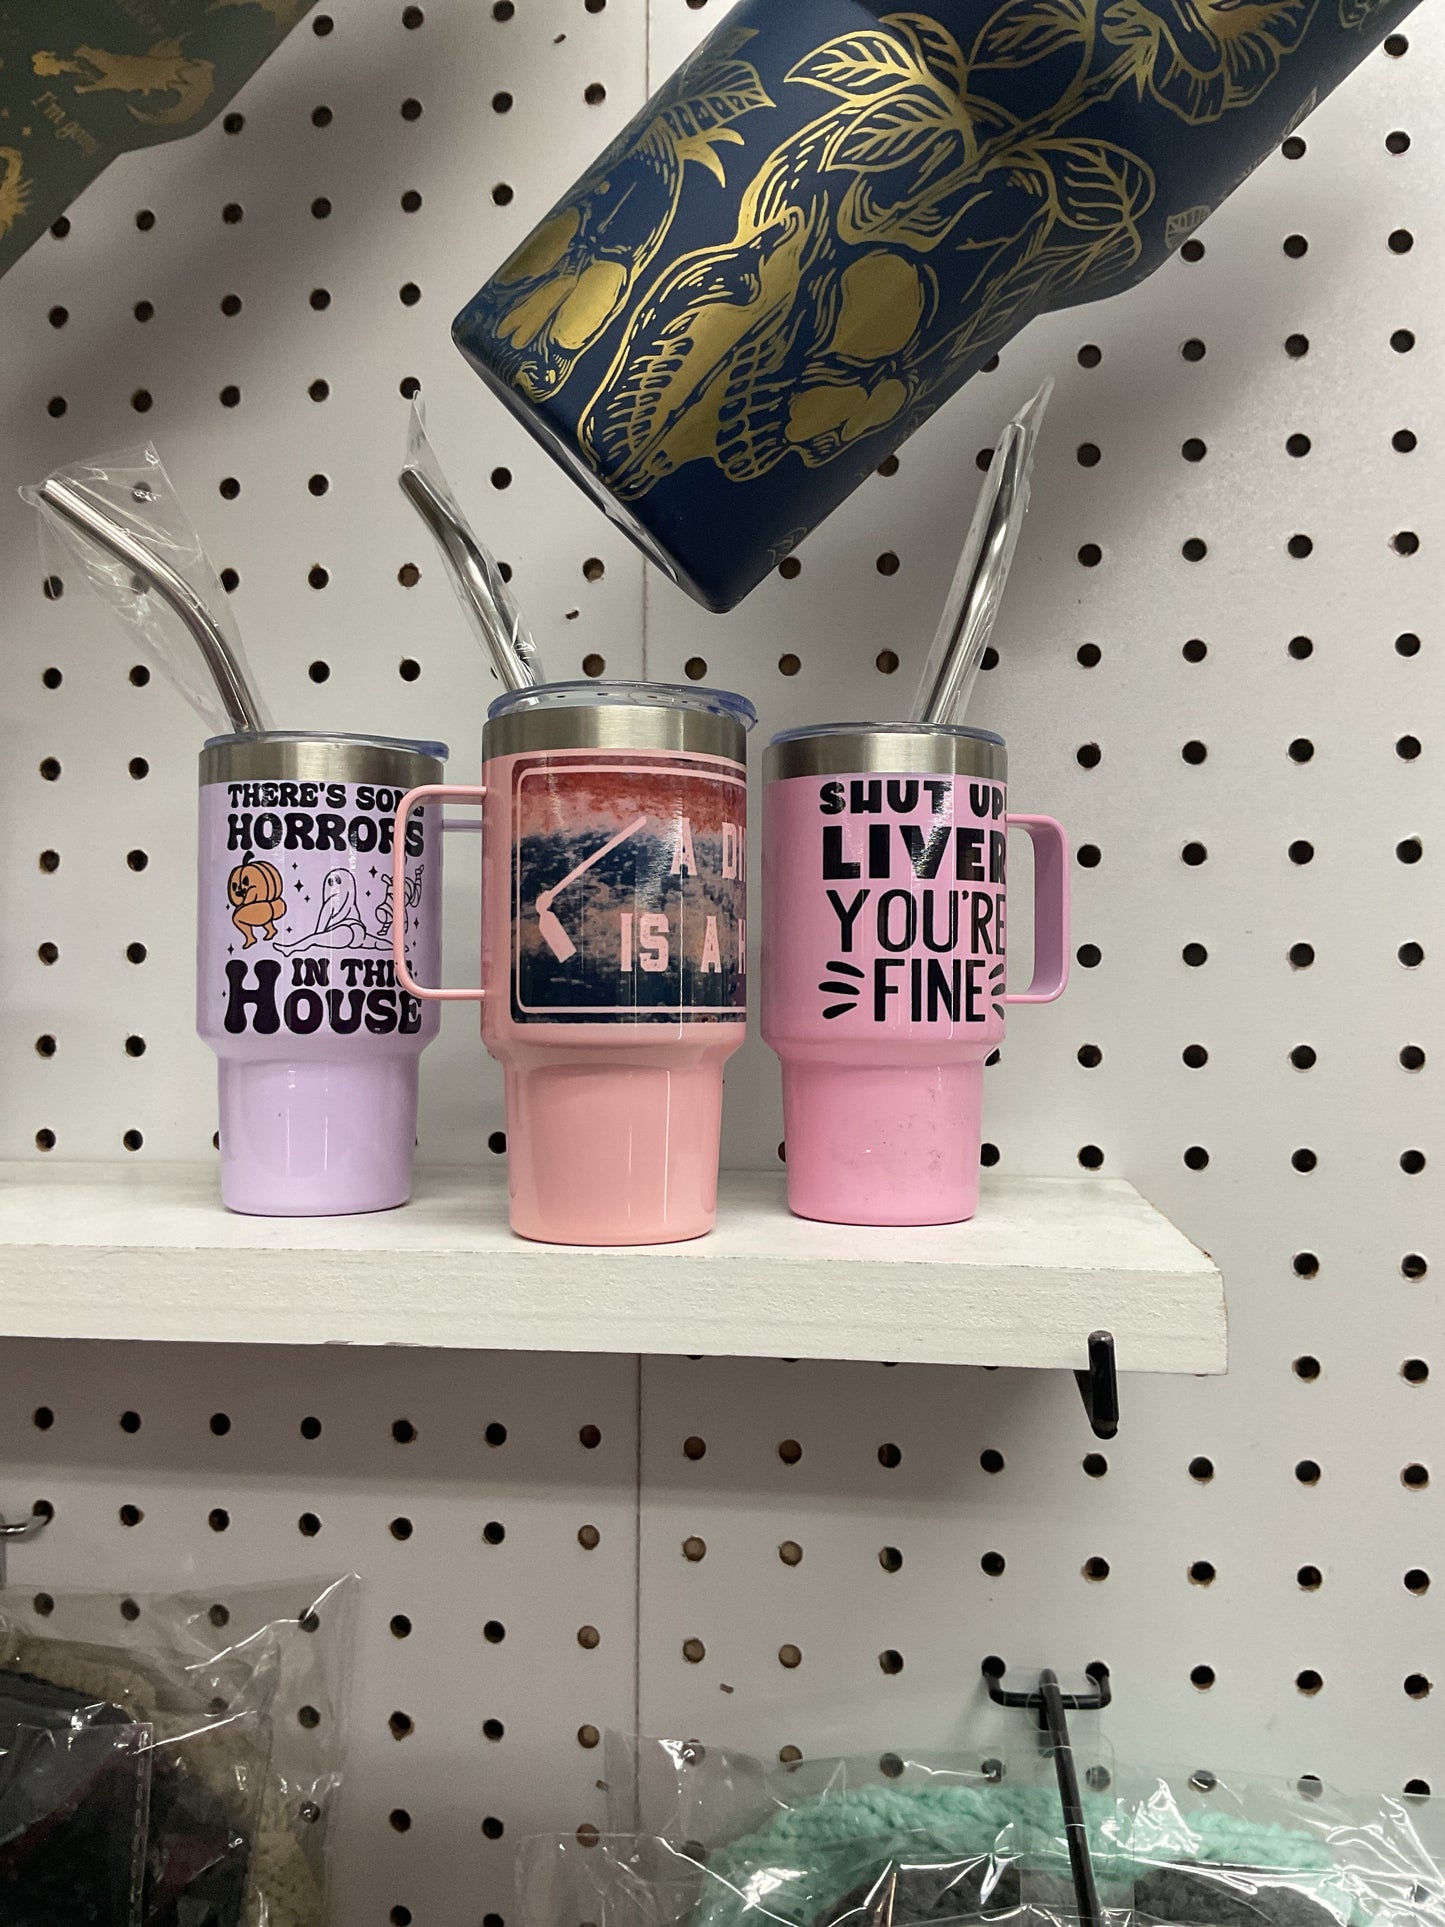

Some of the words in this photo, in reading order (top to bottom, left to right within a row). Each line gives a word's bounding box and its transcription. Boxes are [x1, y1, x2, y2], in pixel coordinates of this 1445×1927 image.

[227, 783, 346, 808] THERE'S
[356, 786, 424, 817] SO
[819, 780, 953, 814] SHUT
[227, 812, 424, 857] HORRORS
[669, 817, 697, 876] A
[823, 824, 1006, 884] LIVER
[620, 912, 669, 972] IS
[700, 915, 722, 973] A
[826, 889, 1006, 955] YOU'RE
[224, 959, 422, 1034] HOUSE
[291, 958, 330, 986] IN
[874, 959, 986, 1022] FINE
